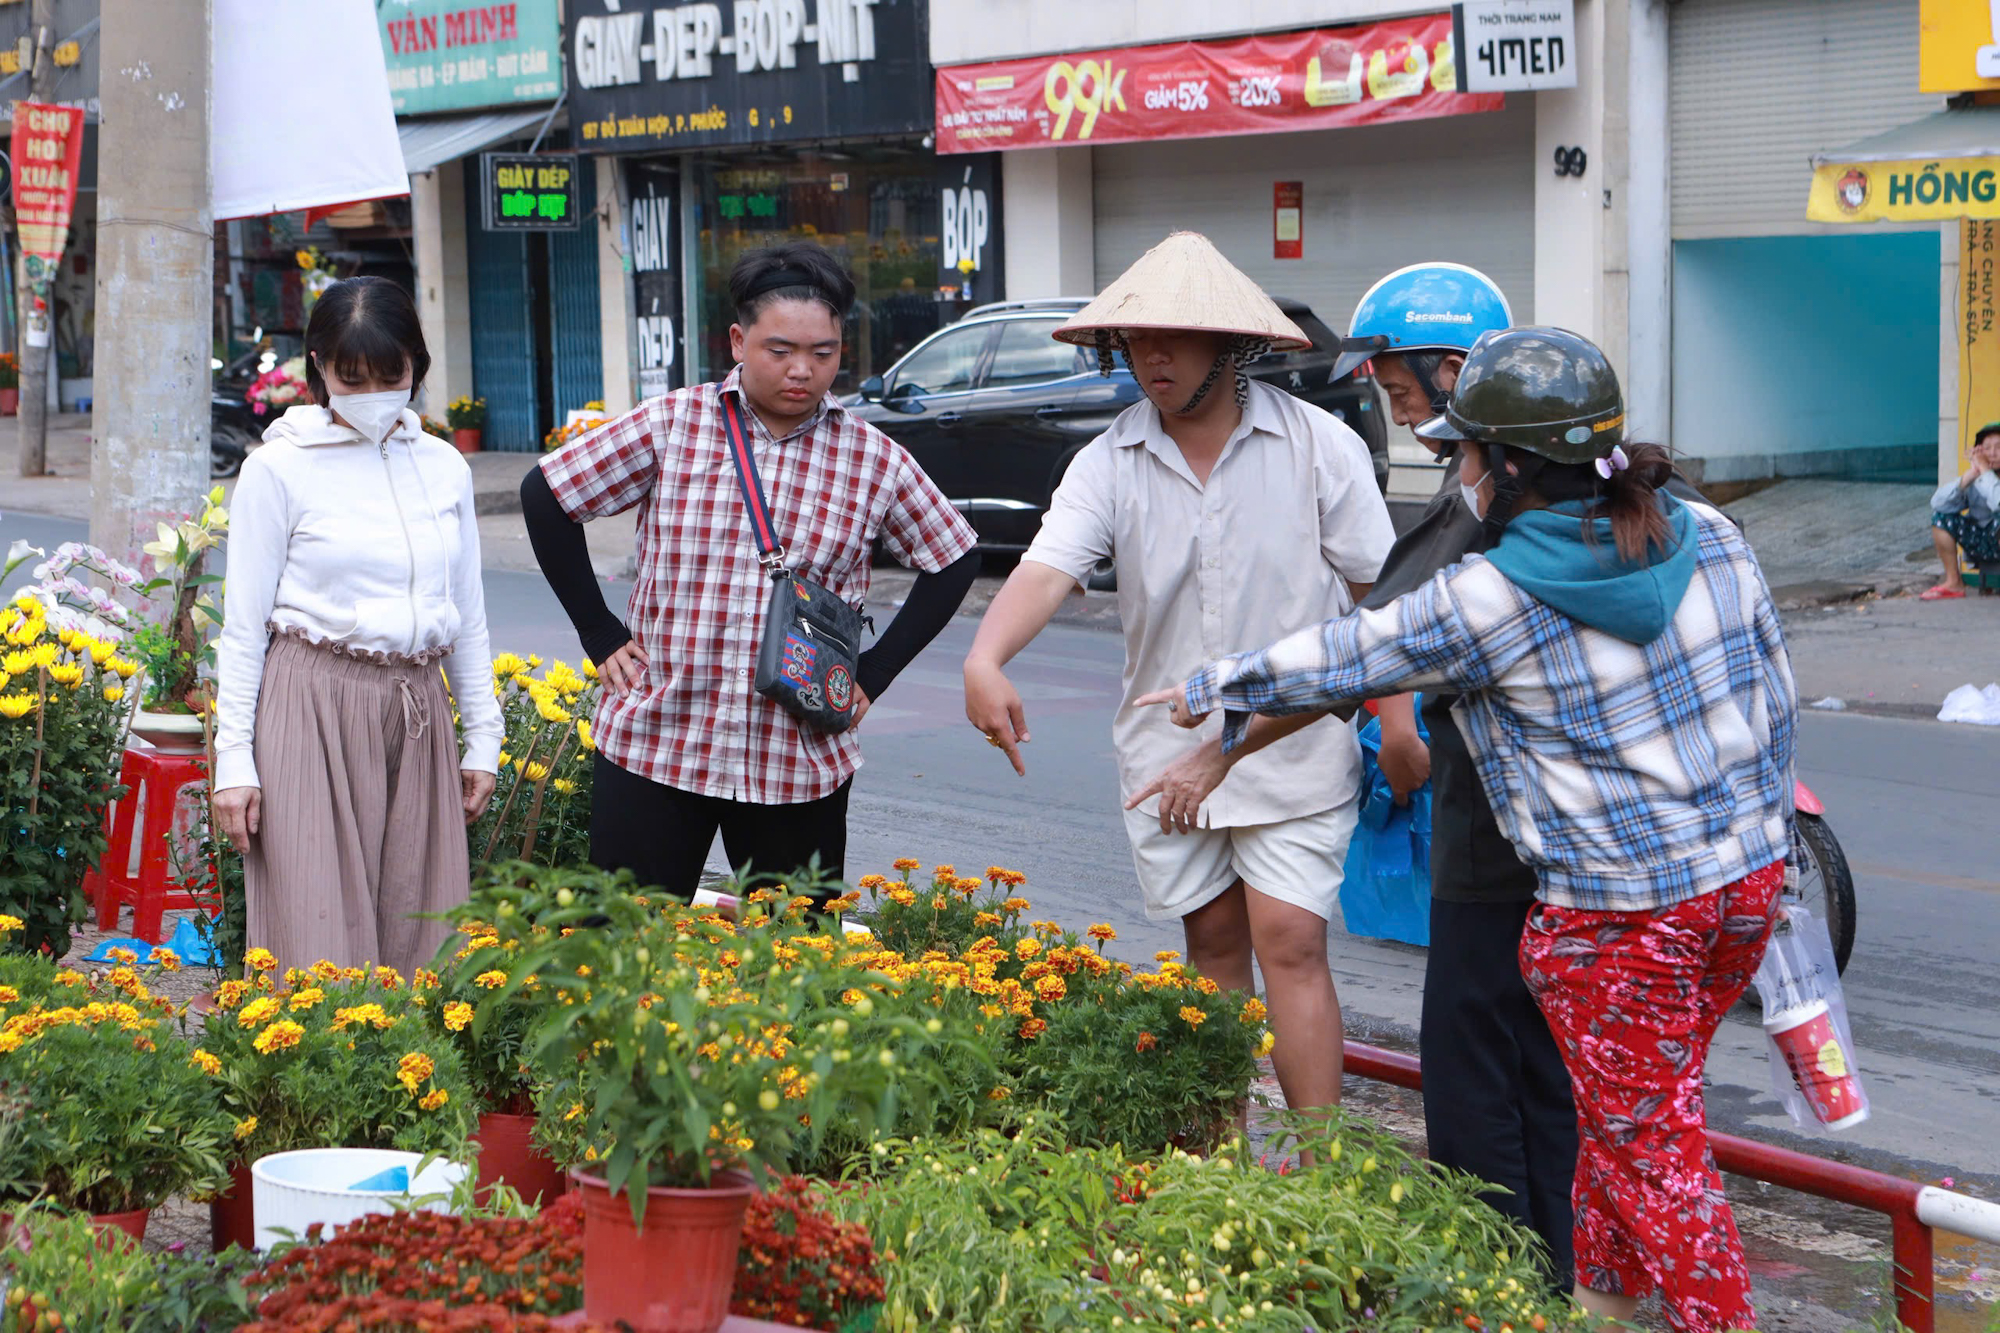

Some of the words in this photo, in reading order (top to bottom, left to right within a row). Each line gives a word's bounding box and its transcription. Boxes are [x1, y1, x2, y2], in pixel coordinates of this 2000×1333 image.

[444, 3, 518, 48] MINH
[1504, 12, 1537, 24] TRANG
[1539, 12, 1562, 23] NAM
[1144, 84, 1178, 109] GIẢM
[1178, 80, 1209, 111] 5%
[1240, 75, 1282, 107] 20%
[497, 163, 534, 189] GIÀY
[537, 164, 570, 189] DÉP
[1554, 145, 1587, 178] 99
[632, 182, 670, 272] GIÀY
[942, 165, 988, 272] BÓP
[1982, 258, 1996, 332] CHUYÊN
[1405, 311, 1474, 324] Sacombank
